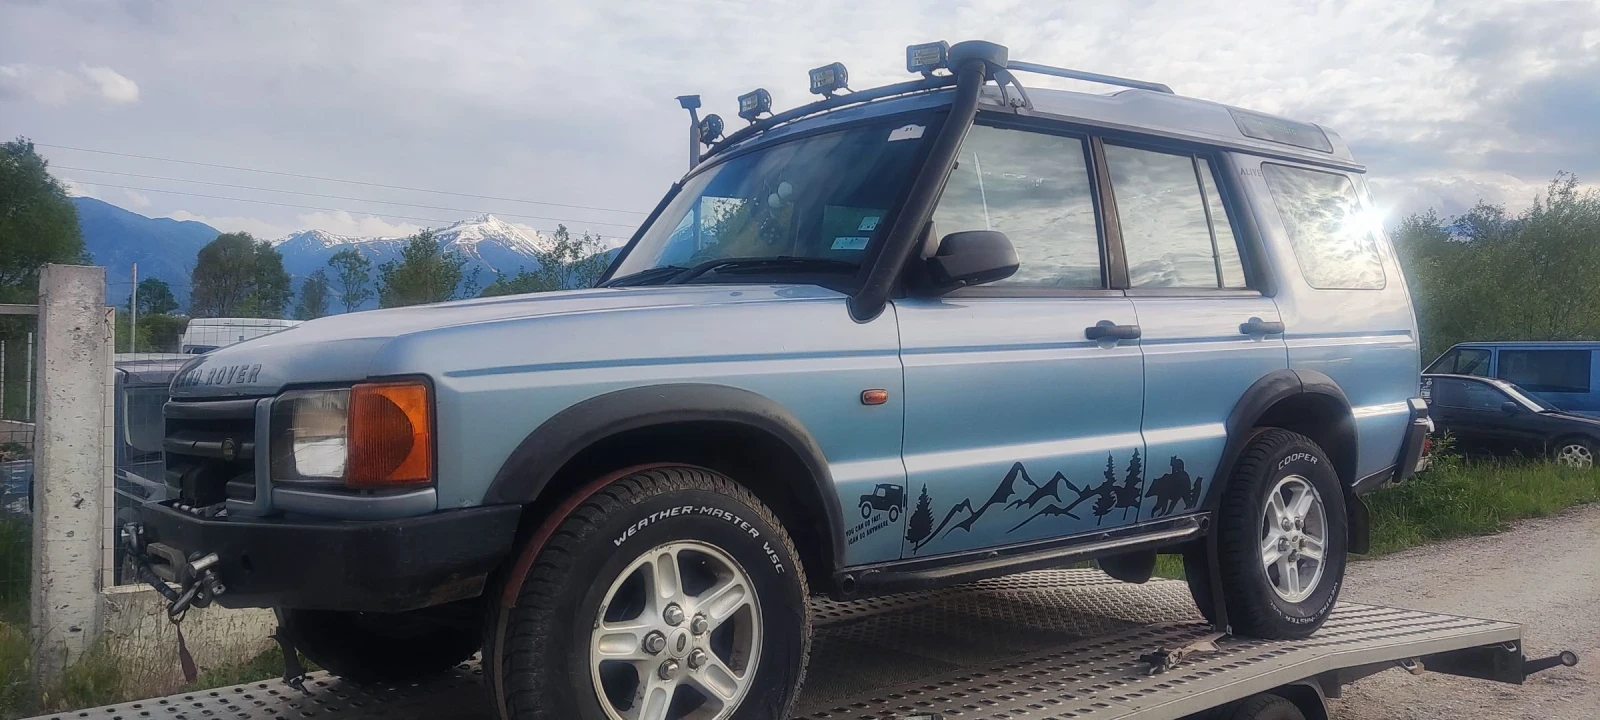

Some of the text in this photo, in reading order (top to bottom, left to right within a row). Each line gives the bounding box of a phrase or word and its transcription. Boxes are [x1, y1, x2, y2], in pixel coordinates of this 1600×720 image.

[206, 364, 262, 385] ROVER
[1278, 452, 1318, 471] COOPER
[855, 522, 864, 532] CAN
[866, 520, 888, 536] ANYWHERE
[613, 505, 785, 574] WEATHER-MASTER WSC
